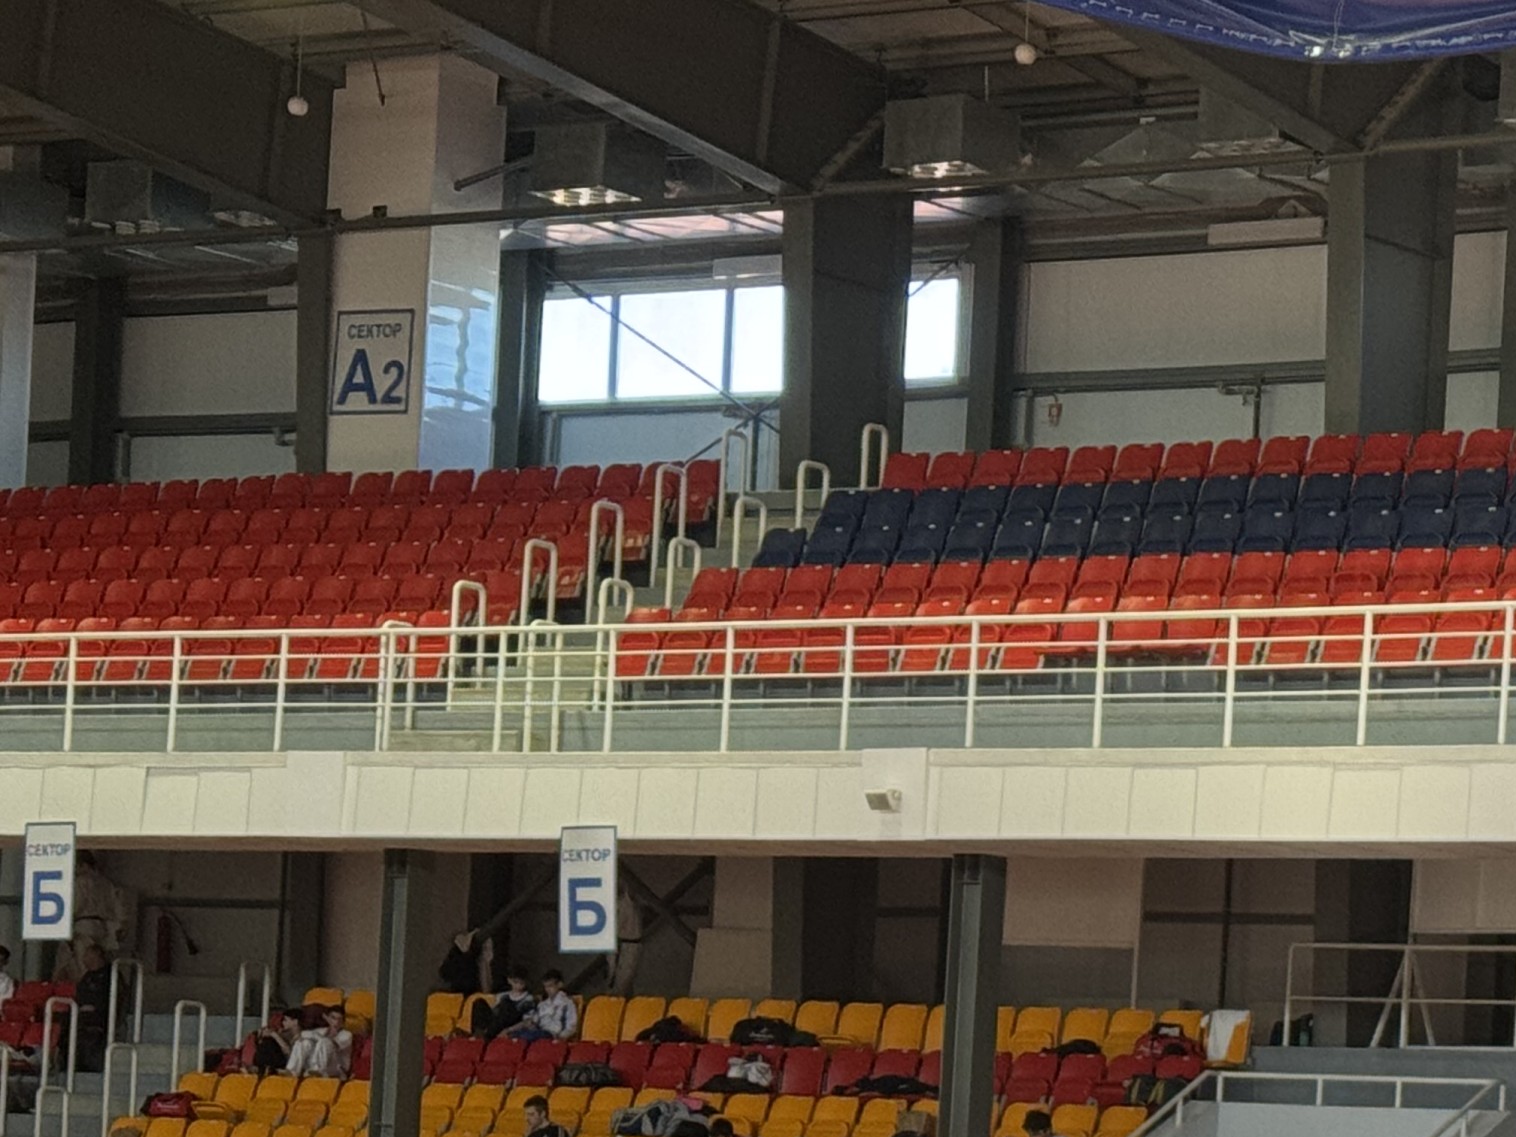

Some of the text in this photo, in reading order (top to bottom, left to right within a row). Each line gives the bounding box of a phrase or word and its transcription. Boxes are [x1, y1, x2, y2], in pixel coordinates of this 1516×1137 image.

[347, 323, 402, 339] СЕКТОР
[336, 348, 405, 405] А2
[26, 843, 71, 857] СЕКТОР
[561, 848, 611, 862] СЕКТОР
[31, 870, 65, 925] Б
[568, 878, 607, 936] Б
